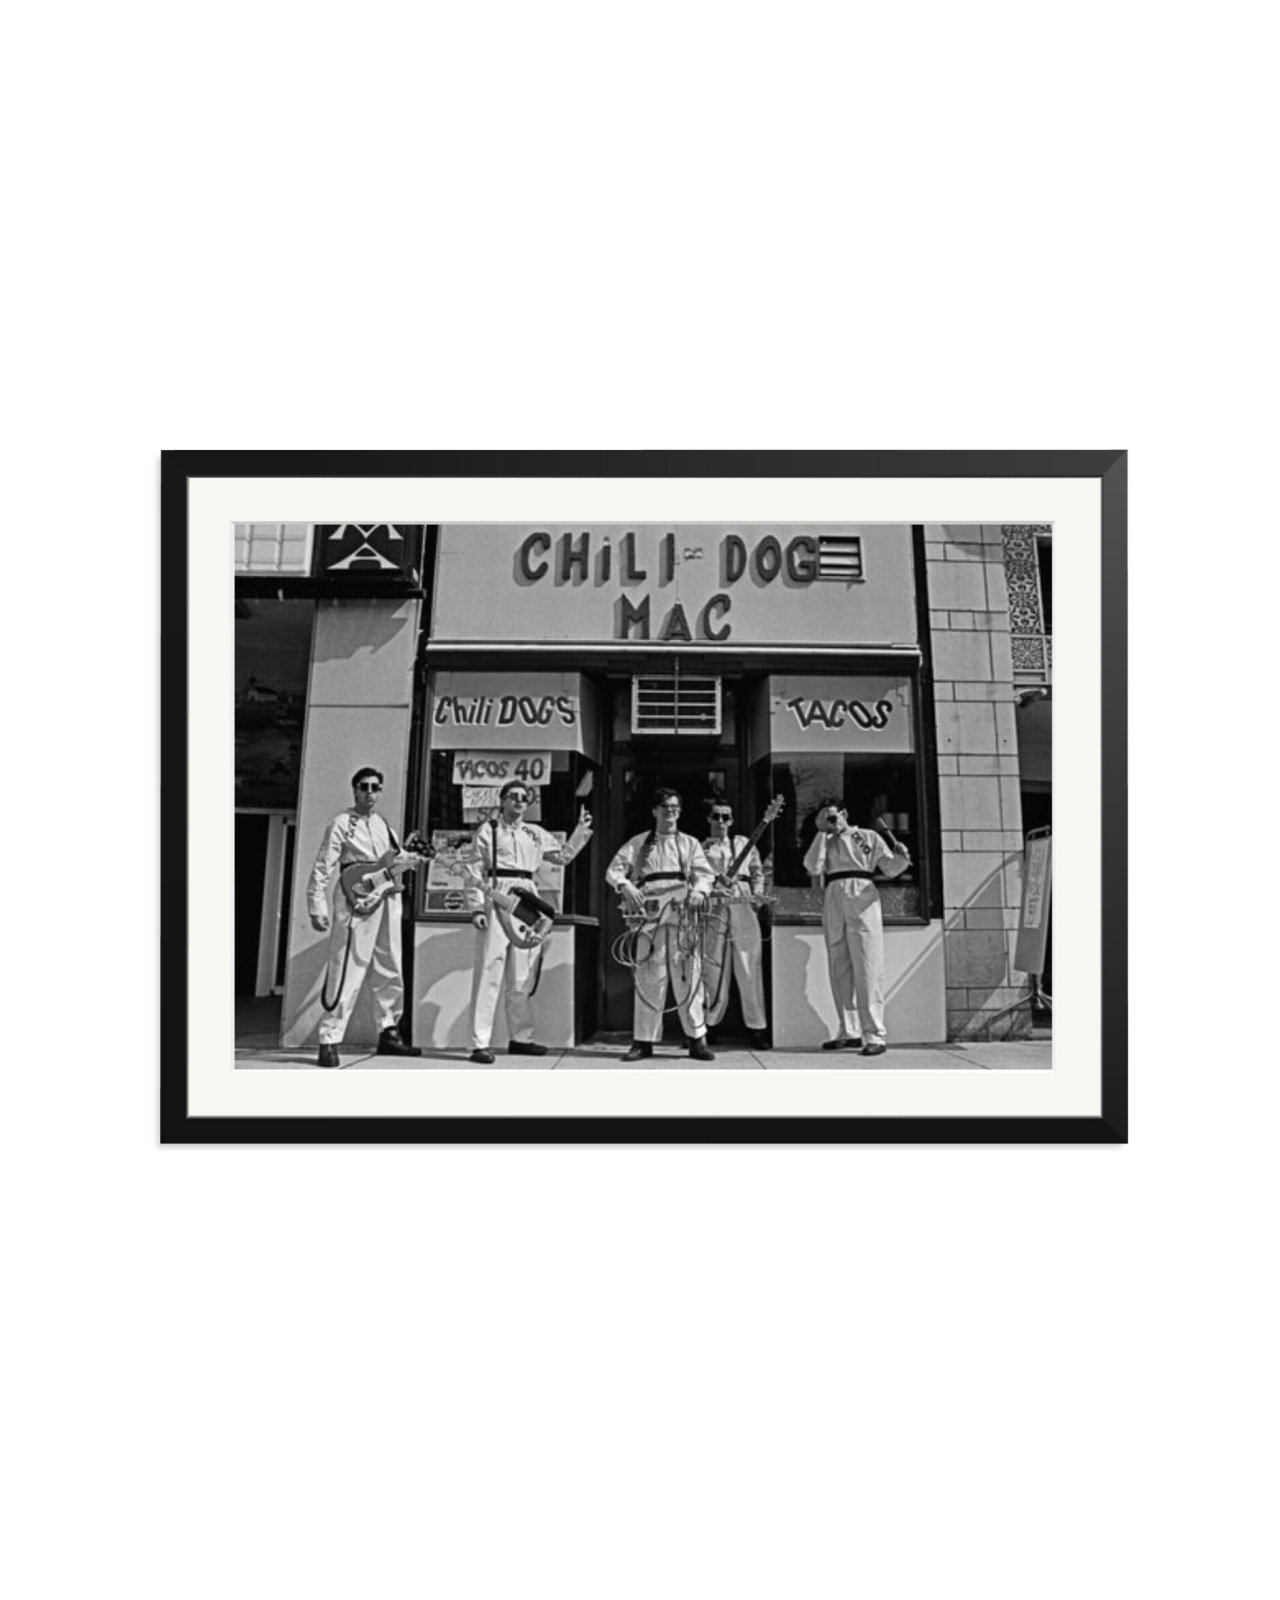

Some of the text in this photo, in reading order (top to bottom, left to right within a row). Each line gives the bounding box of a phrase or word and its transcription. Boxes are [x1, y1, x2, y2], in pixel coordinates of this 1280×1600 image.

[719, 534, 817, 588] DOG
[613, 592, 731, 641] MAC
[434, 695, 576, 726] Chili DOGS
[787, 696, 893, 730] TACOS
[455, 759, 510, 780] TACOS
